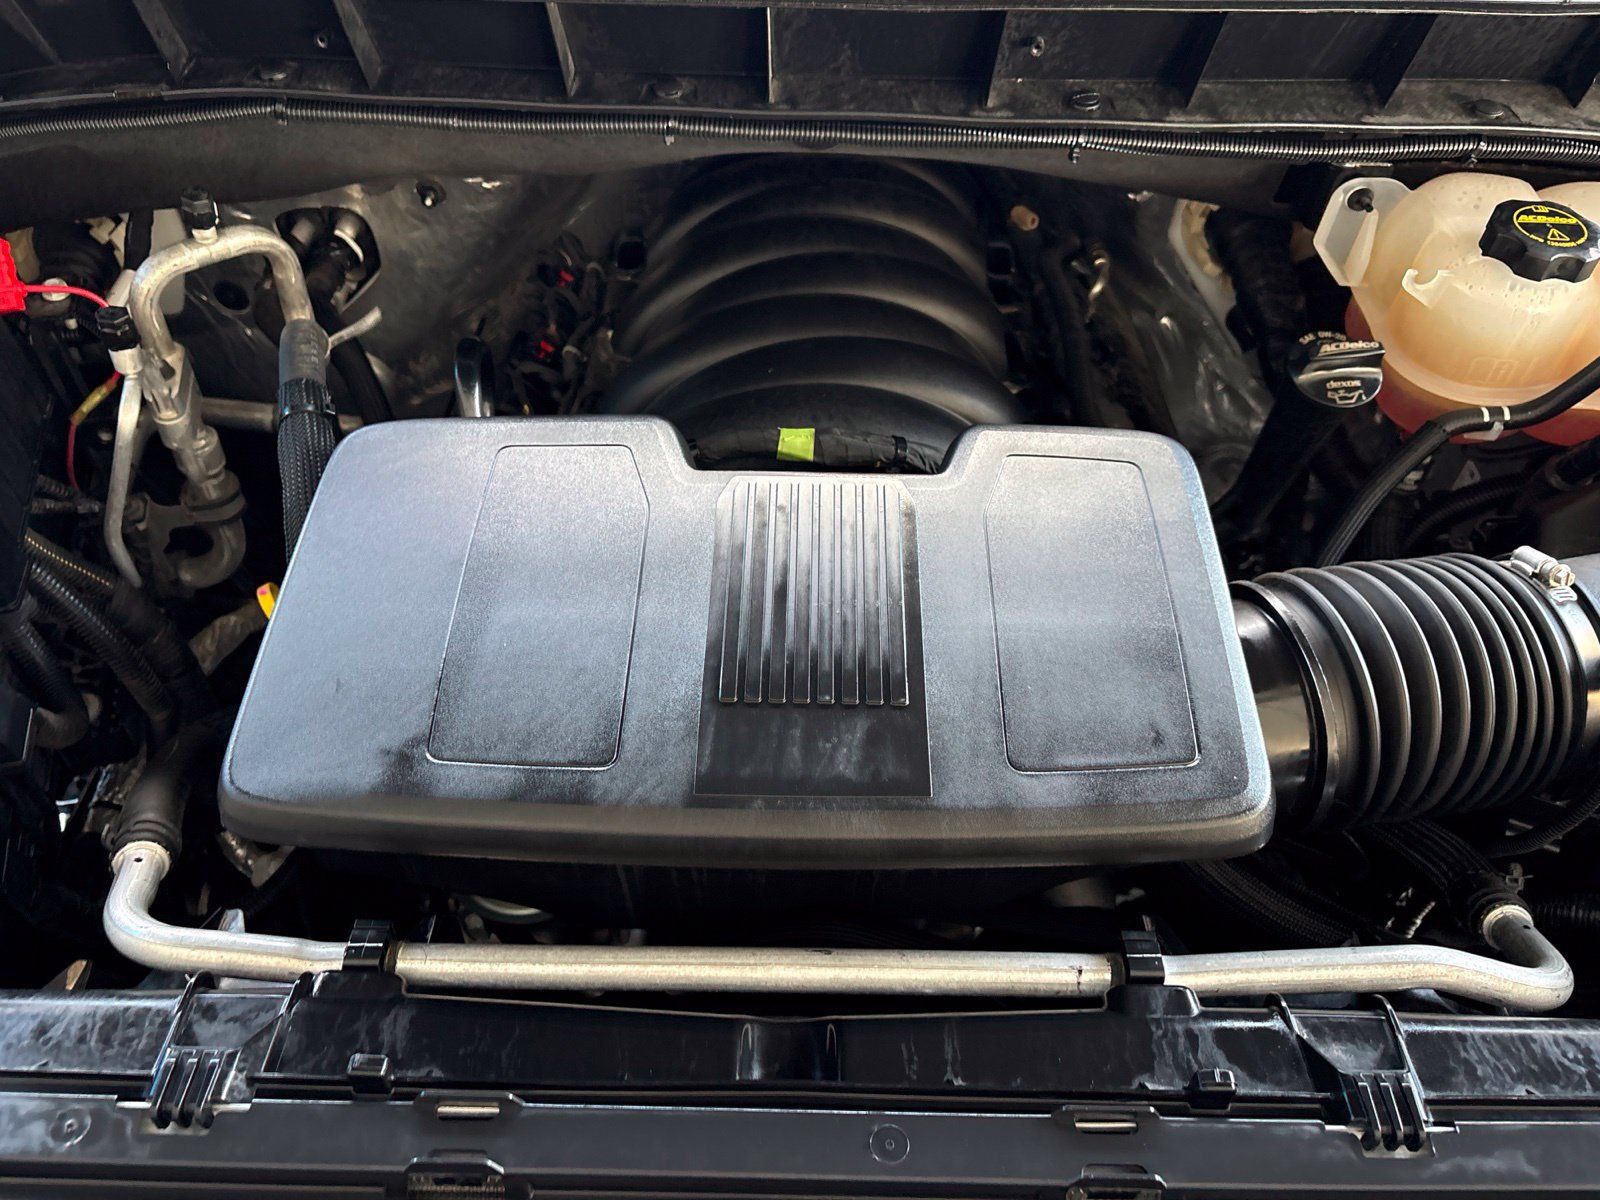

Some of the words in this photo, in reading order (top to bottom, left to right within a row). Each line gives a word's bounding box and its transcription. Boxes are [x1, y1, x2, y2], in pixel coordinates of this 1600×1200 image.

[1518, 215, 1578, 224] ACDelco
[1299, 333, 1316, 344] SAE
[1320, 340, 1380, 353] ACDelco
[1326, 380, 1361, 389] dexos
